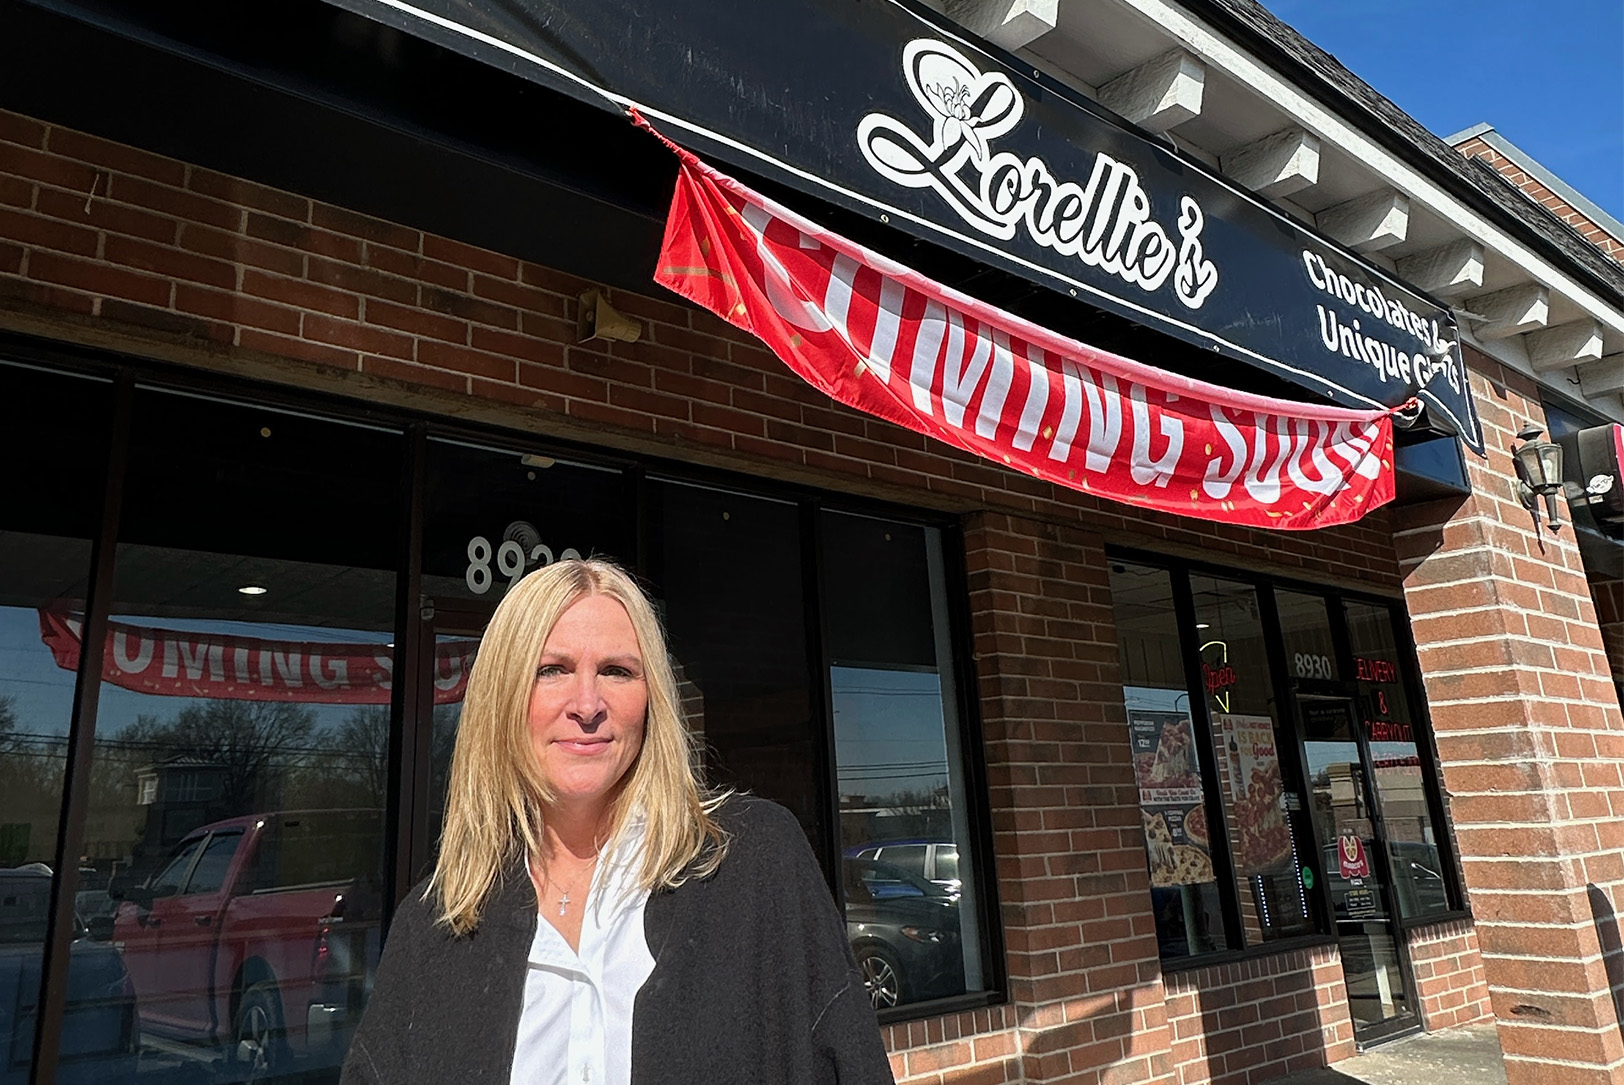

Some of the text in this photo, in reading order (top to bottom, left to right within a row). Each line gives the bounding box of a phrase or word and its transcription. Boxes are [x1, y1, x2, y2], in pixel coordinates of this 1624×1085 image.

[857, 37, 1217, 309] Lorellie's
[1303, 250, 1431, 347] Chocolates
[1317, 304, 1411, 385] Unique
[466, 536, 582, 594] 89
[1294, 652, 1332, 679] 8930
[1237, 731, 1272, 744] IS BACK
[1252, 742, 1274, 760] Good
